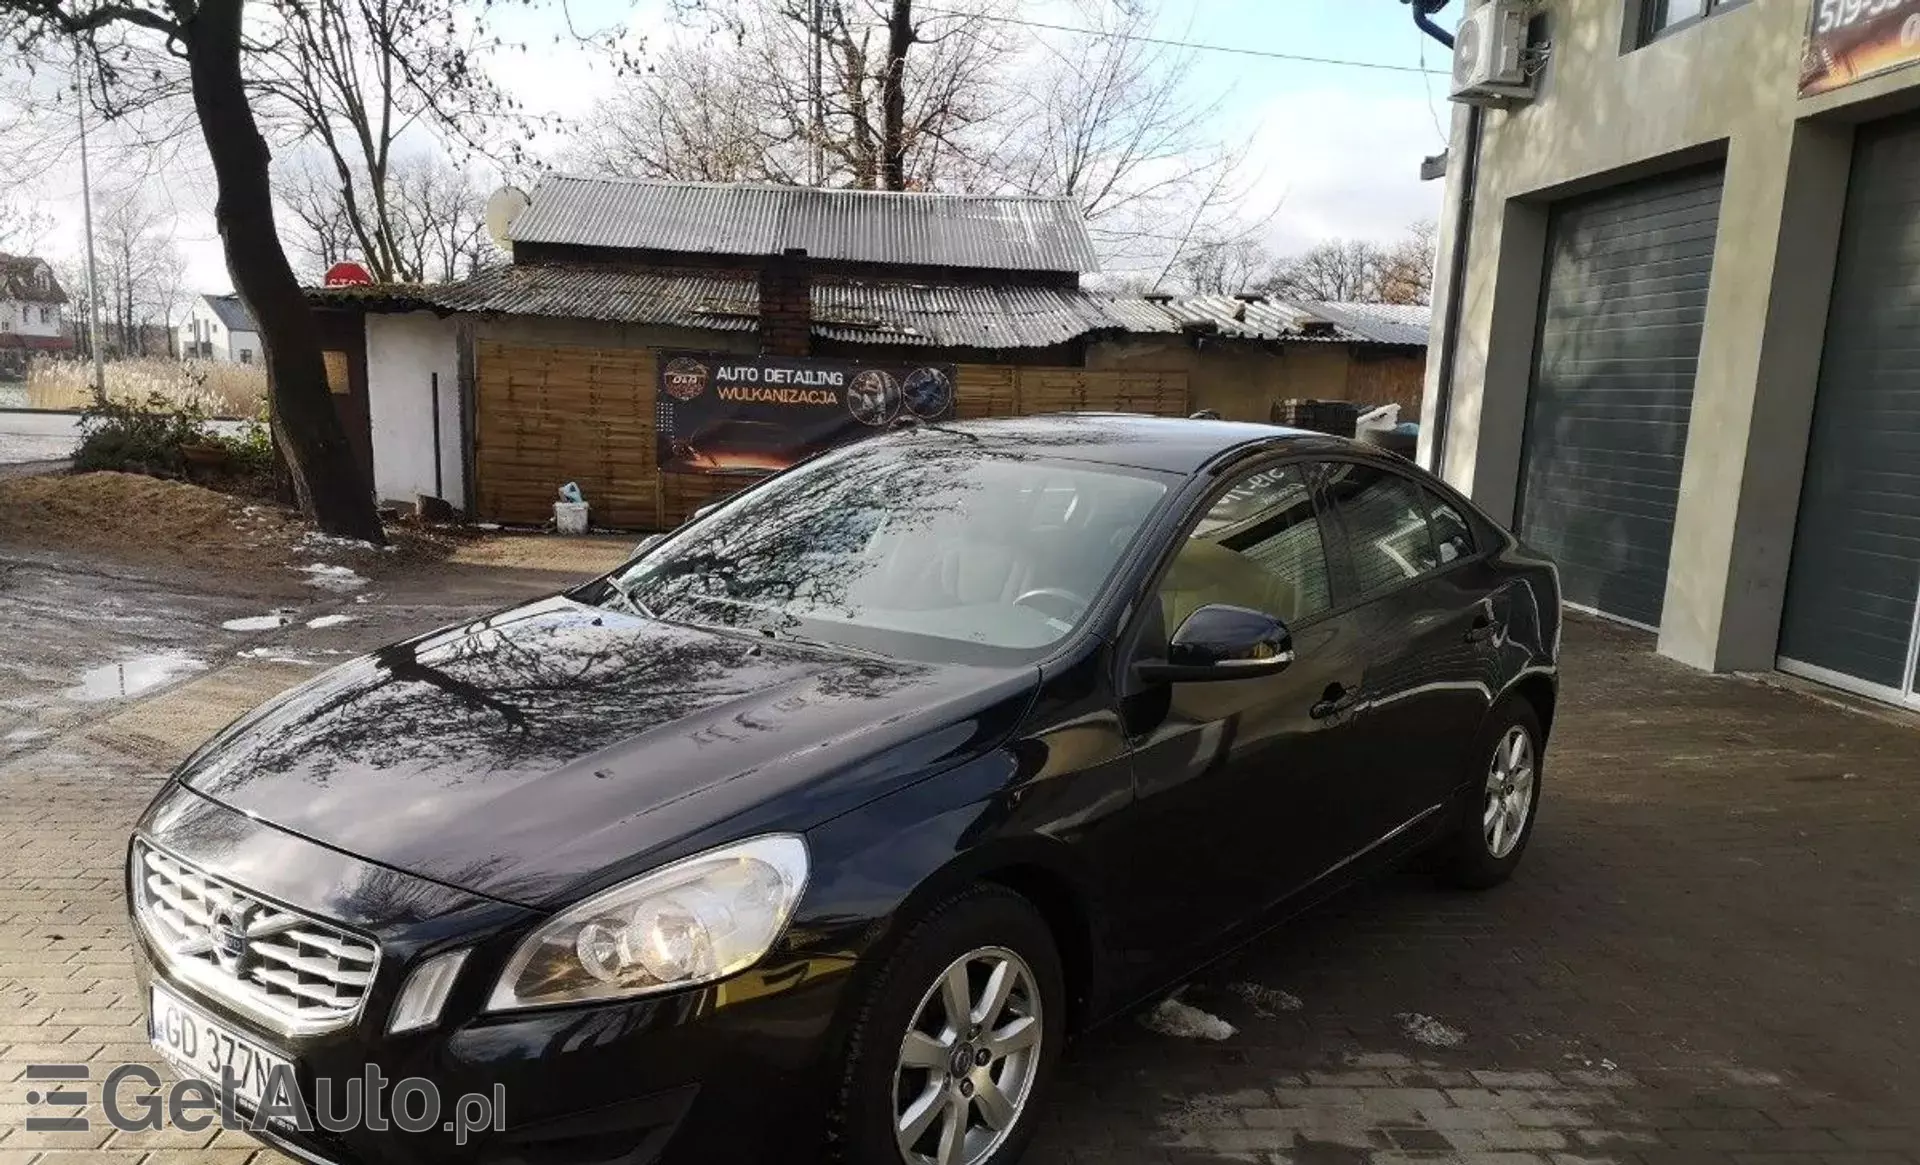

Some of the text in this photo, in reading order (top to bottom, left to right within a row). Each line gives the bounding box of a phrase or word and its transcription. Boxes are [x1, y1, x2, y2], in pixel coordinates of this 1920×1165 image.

[716, 366, 844, 386] AUTO DETAILING
[716, 385, 838, 405] WULKANIZACJA
[165, 1004, 197, 1059] GD
